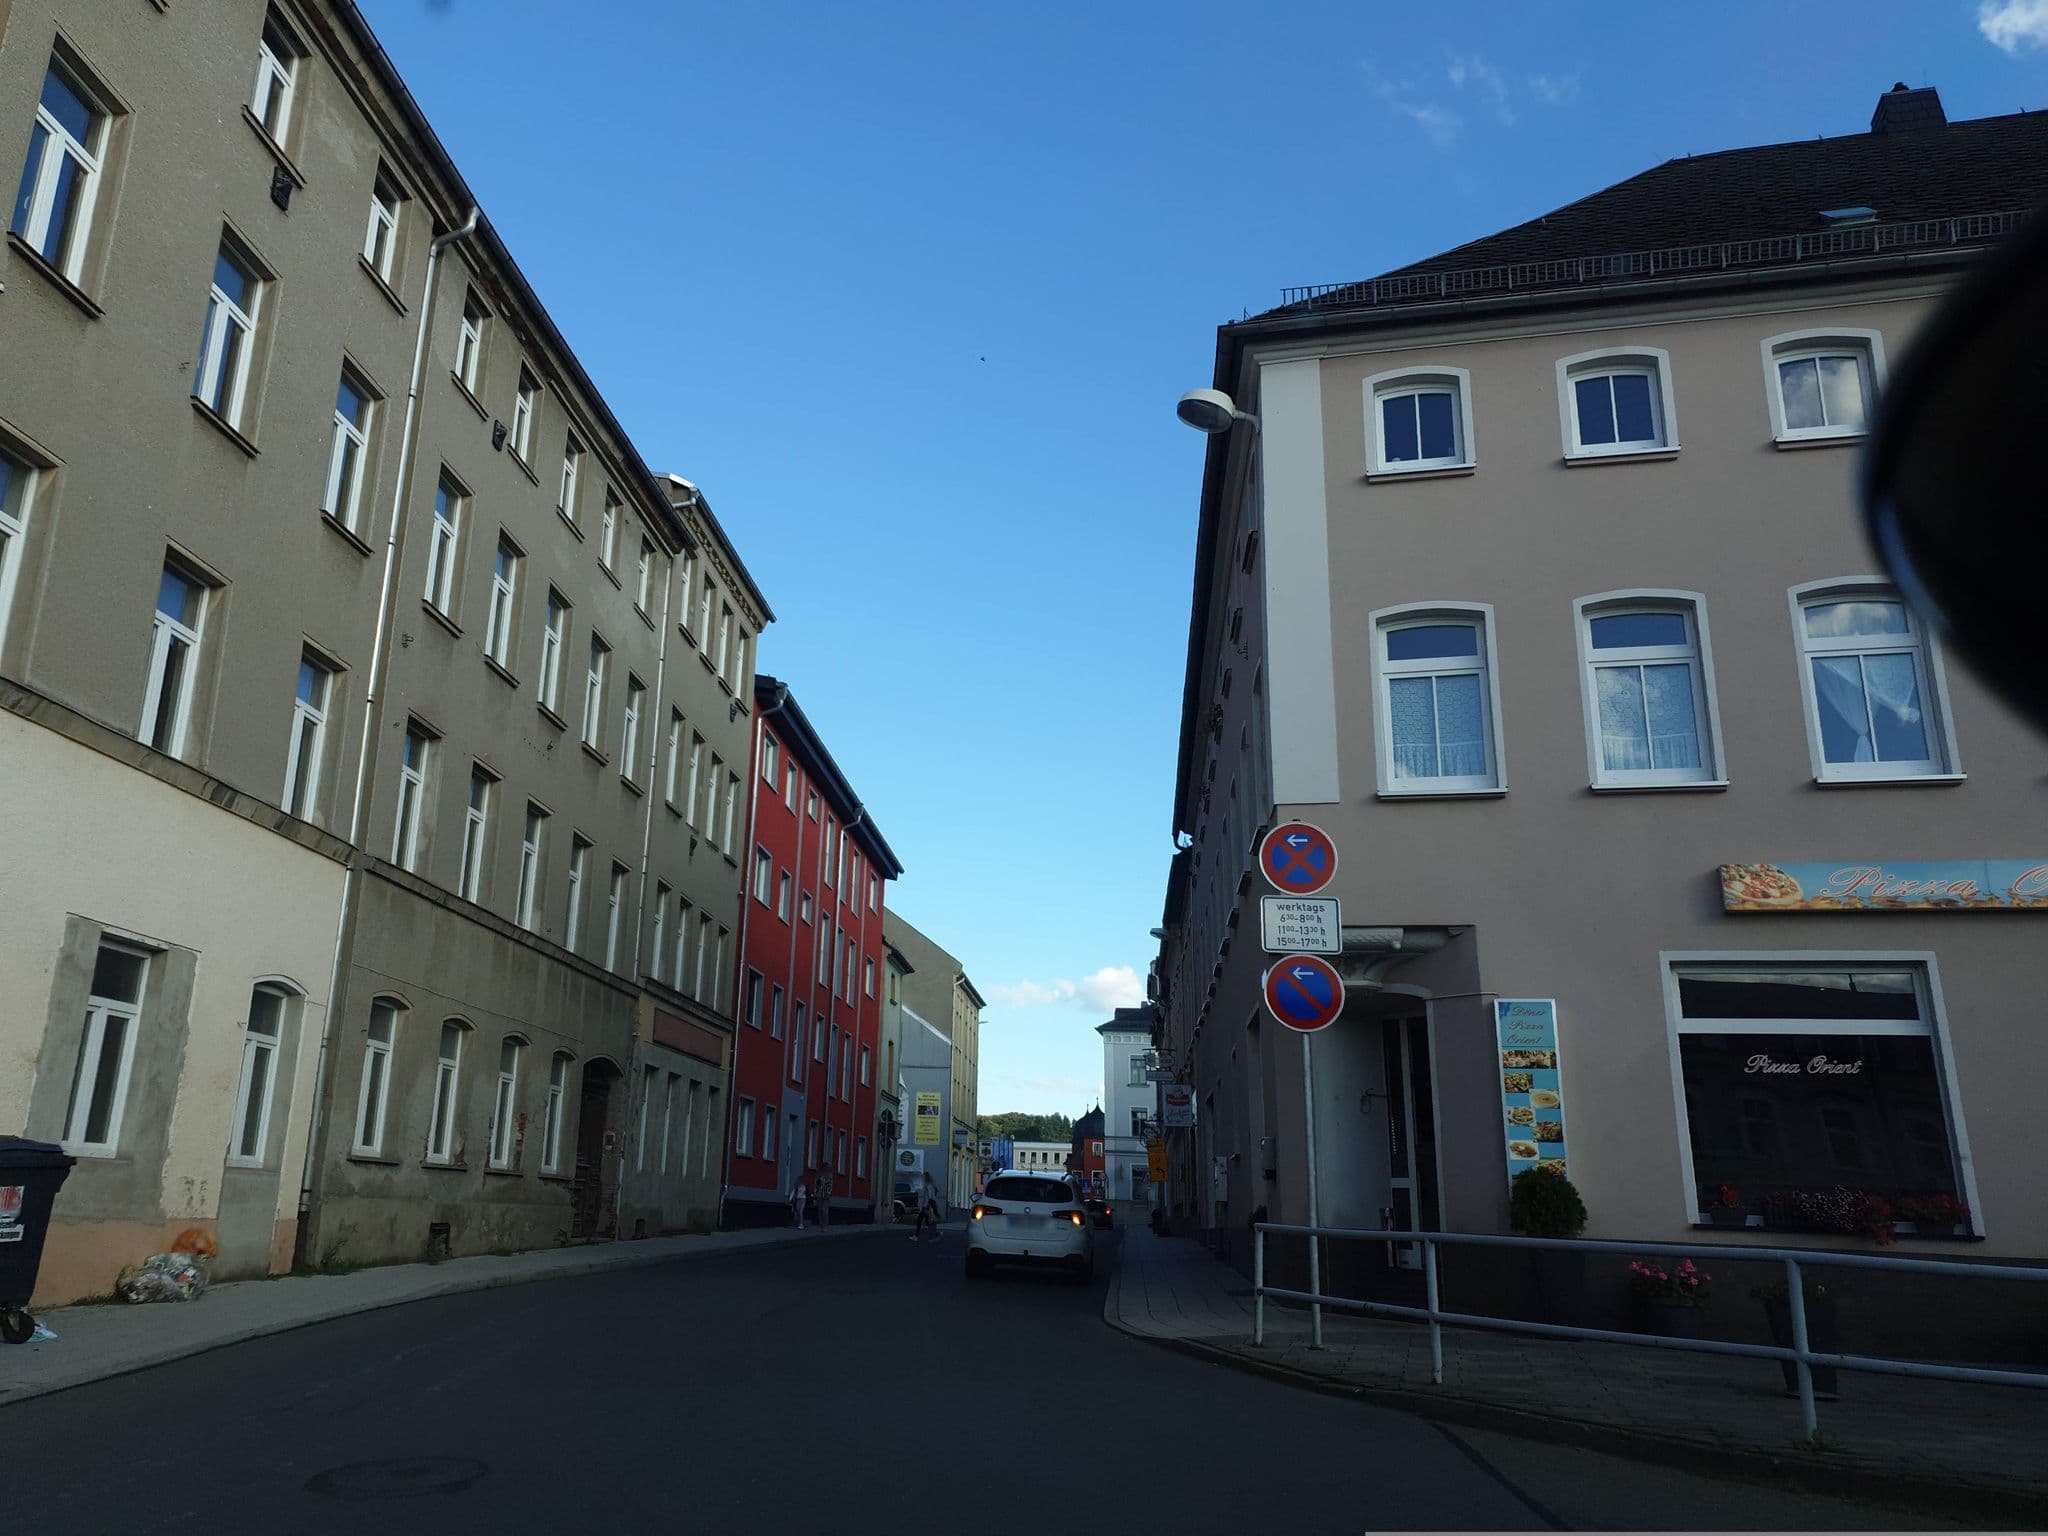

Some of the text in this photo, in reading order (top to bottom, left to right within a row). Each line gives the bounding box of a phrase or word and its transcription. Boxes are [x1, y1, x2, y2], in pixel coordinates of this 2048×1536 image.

[1820, 866, 1978, 896] Pizza
[1276, 902, 1325, 914] werktags
[1316, 915, 1322, 924] h
[1320, 926, 1326, 936] h
[1321, 938, 1327, 948] h
[1743, 1054, 1864, 1074] Pizza Orient
